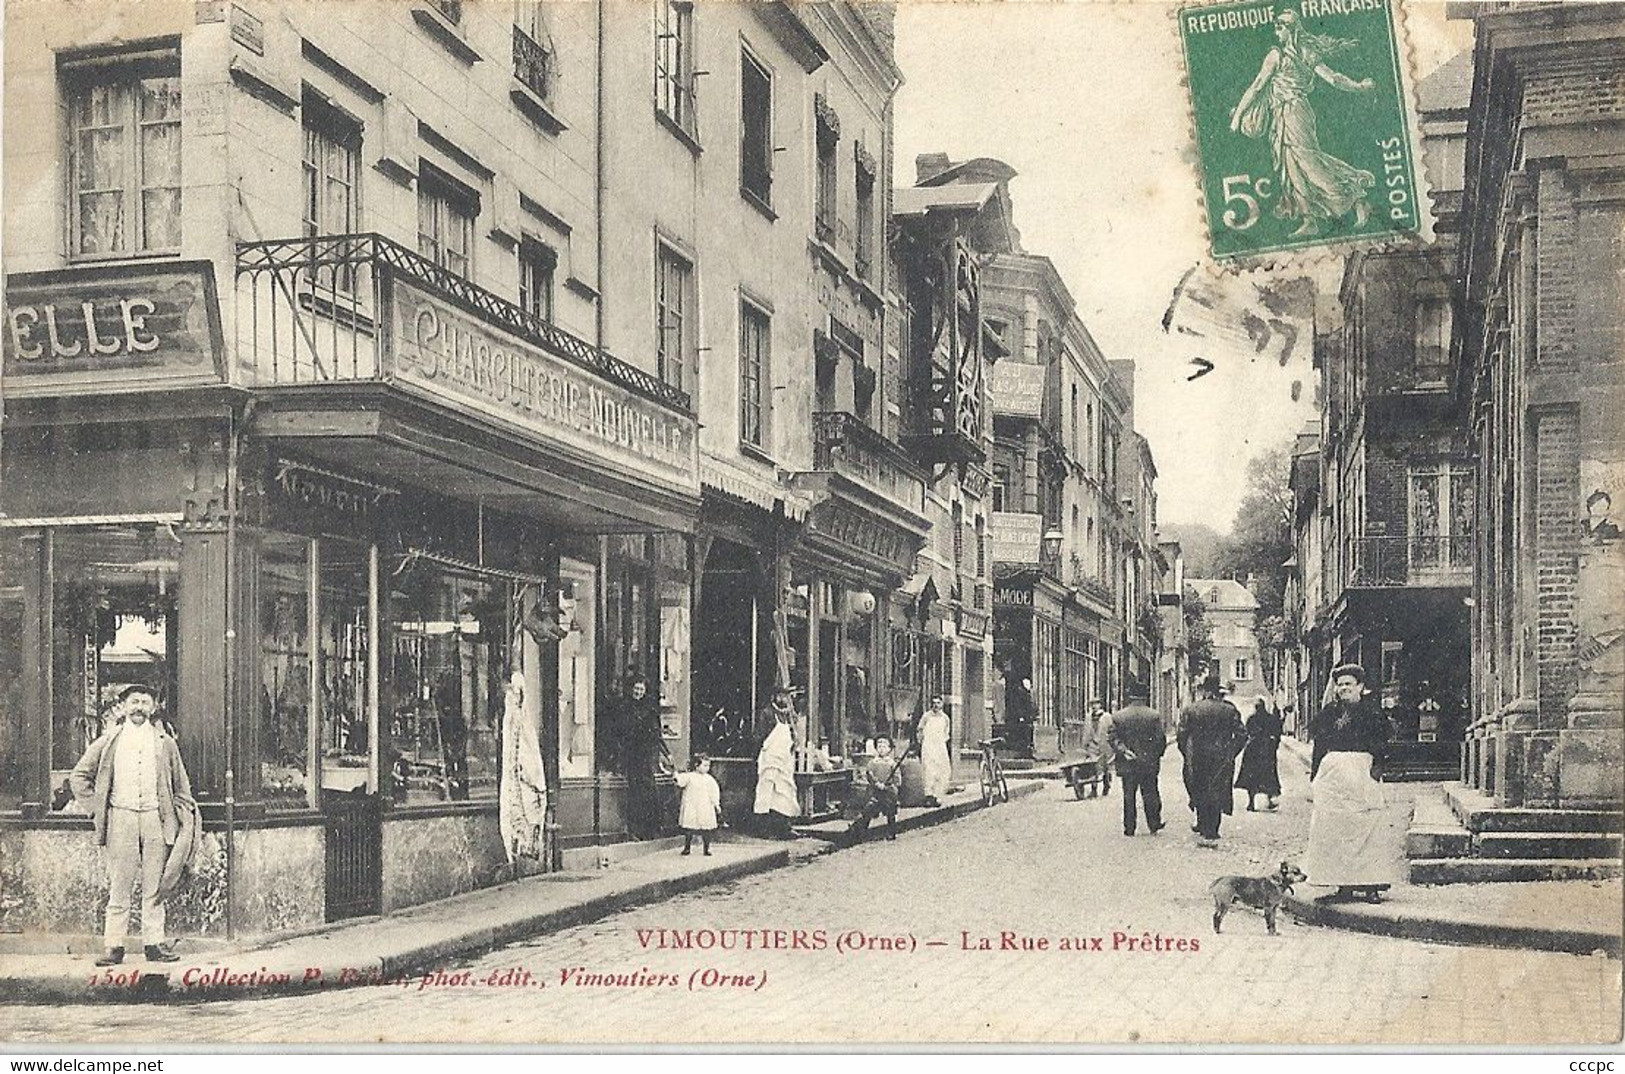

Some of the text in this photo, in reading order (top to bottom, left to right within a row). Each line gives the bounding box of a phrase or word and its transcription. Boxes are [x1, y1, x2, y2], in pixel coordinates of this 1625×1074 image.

[9, 299, 160, 360] ELLE
[398, 301, 684, 464] CHARCUTERIE NOUVELLE
